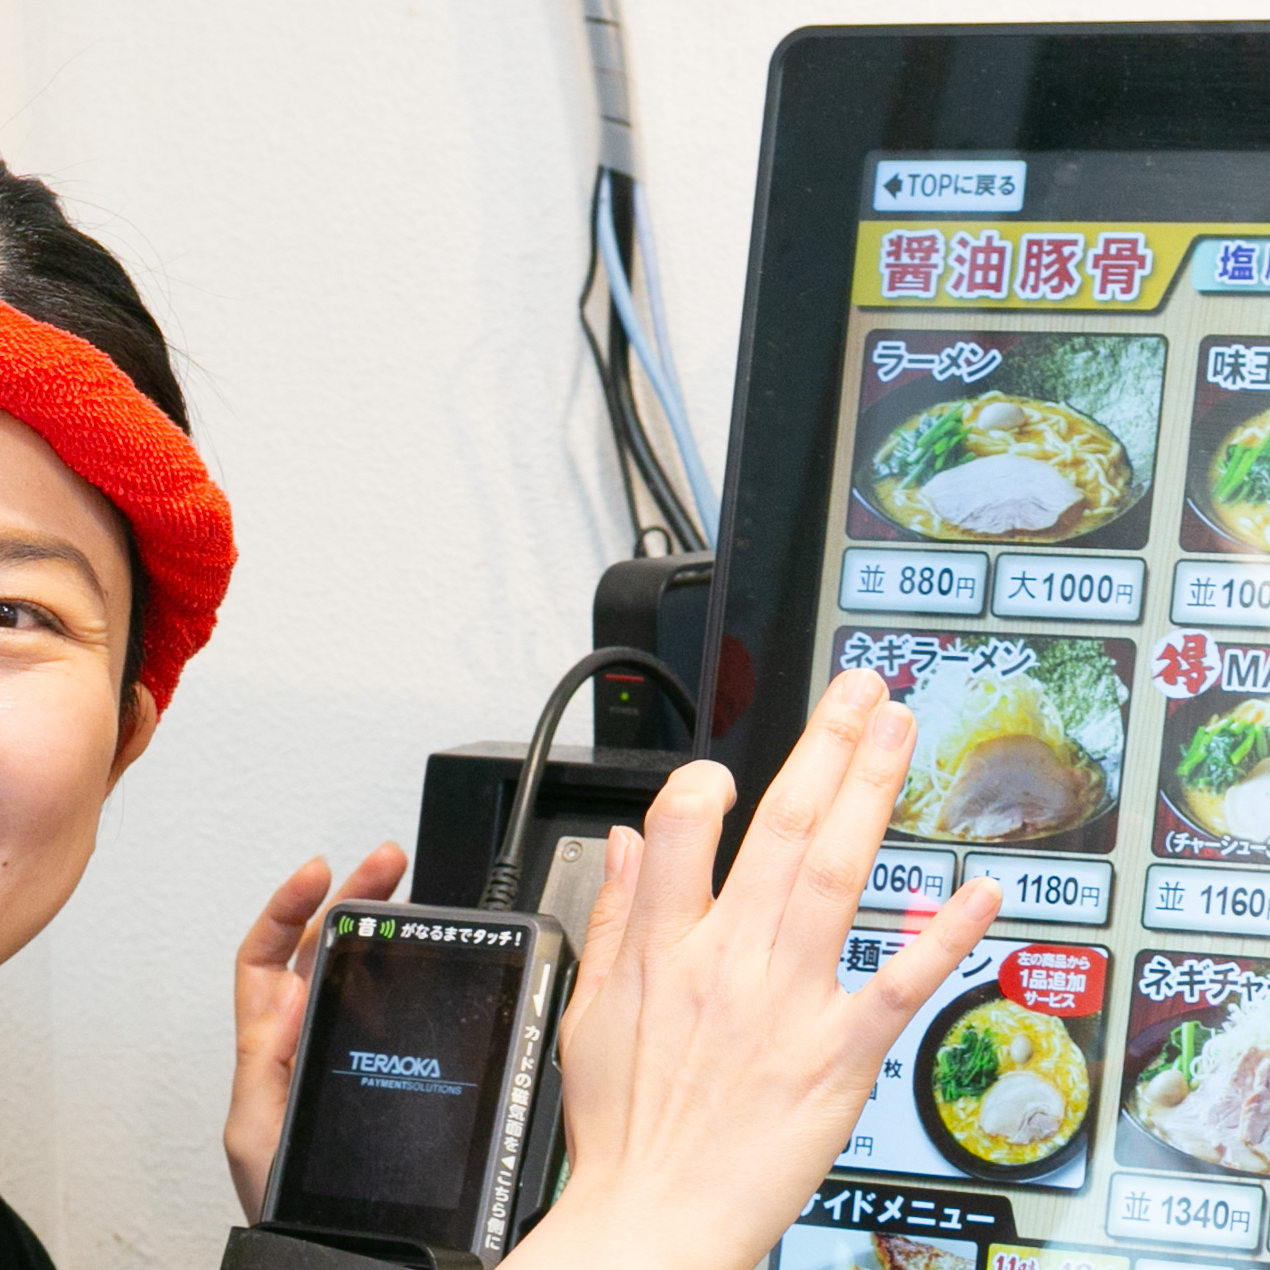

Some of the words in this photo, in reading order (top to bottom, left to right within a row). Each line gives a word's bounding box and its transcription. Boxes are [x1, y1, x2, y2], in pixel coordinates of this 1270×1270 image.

[907, 172, 1017, 198] TOPに戻る
[882, 232, 1151, 299] 醤油豚骨
[875, 342, 1001, 382] ラーメン
[840, 633, 1039, 684] ネギラーメン
[863, 862, 944, 897] 060円
[1020, 969, 1086, 992] 1品追加
[1024, 991, 1075, 1008] サービス
[349, 1051, 440, 1078] TERAOKA
